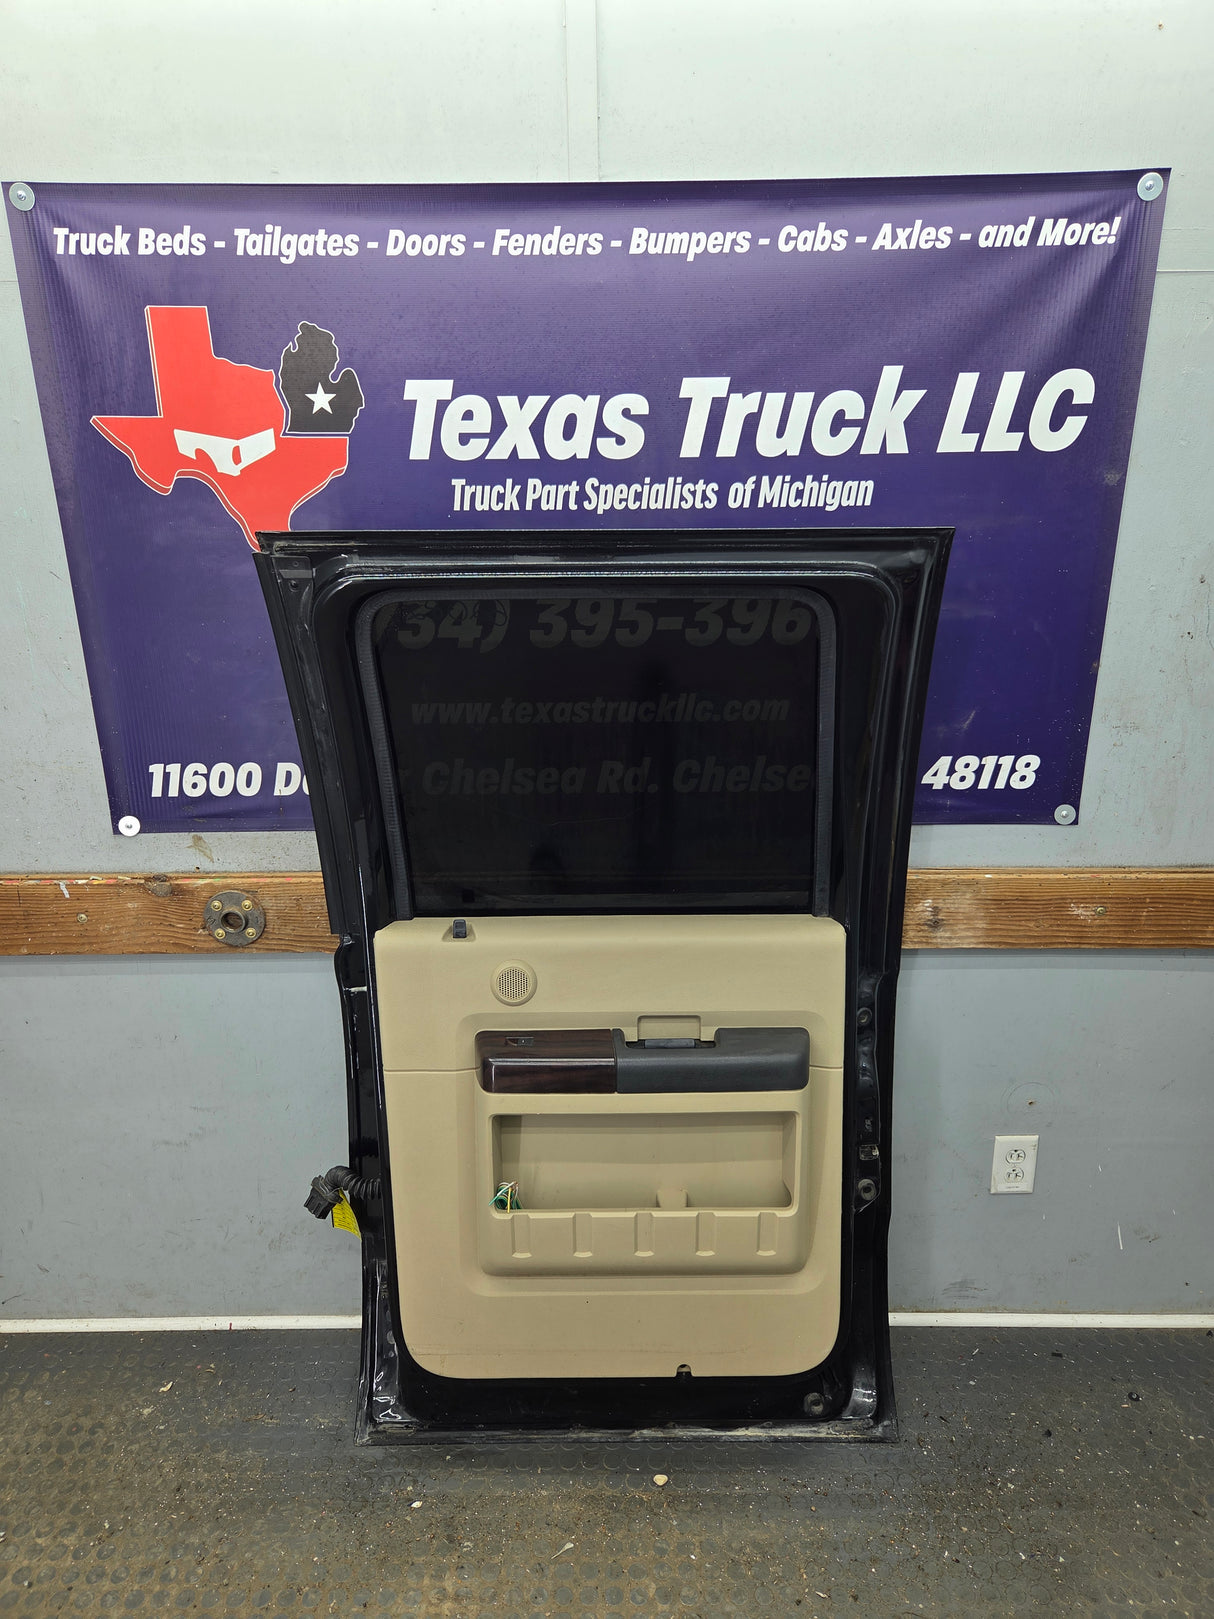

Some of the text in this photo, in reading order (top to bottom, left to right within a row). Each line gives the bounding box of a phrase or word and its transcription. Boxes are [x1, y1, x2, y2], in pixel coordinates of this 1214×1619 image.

[52, 224, 132, 256] Truck
[137, 224, 207, 256] Beds
[233, 223, 360, 265] Tailgates
[385, 228, 467, 257] Doors
[491, 225, 604, 257] Fenders
[628, 226, 752, 262] Bumpers
[777, 221, 849, 253] Cabs
[871, 219, 954, 251] Axles
[978, 215, 1037, 248] and
[1036, 215, 1122, 247] More!
[403, 364, 1096, 461] Texas Truck LLC
[451, 474, 875, 515] Truck Part Specialists of Michigan
[374, 599, 511, 654] 34)
[529, 599, 813, 649] 395-396
[412, 693, 791, 725] www.texastruckllc.com
[148, 761, 263, 798] 11600
[422, 757, 587, 795] Chelsea
[596, 756, 659, 794] Rd.
[672, 755, 812, 793] Chelse
[920, 754, 1041, 790] 48118
